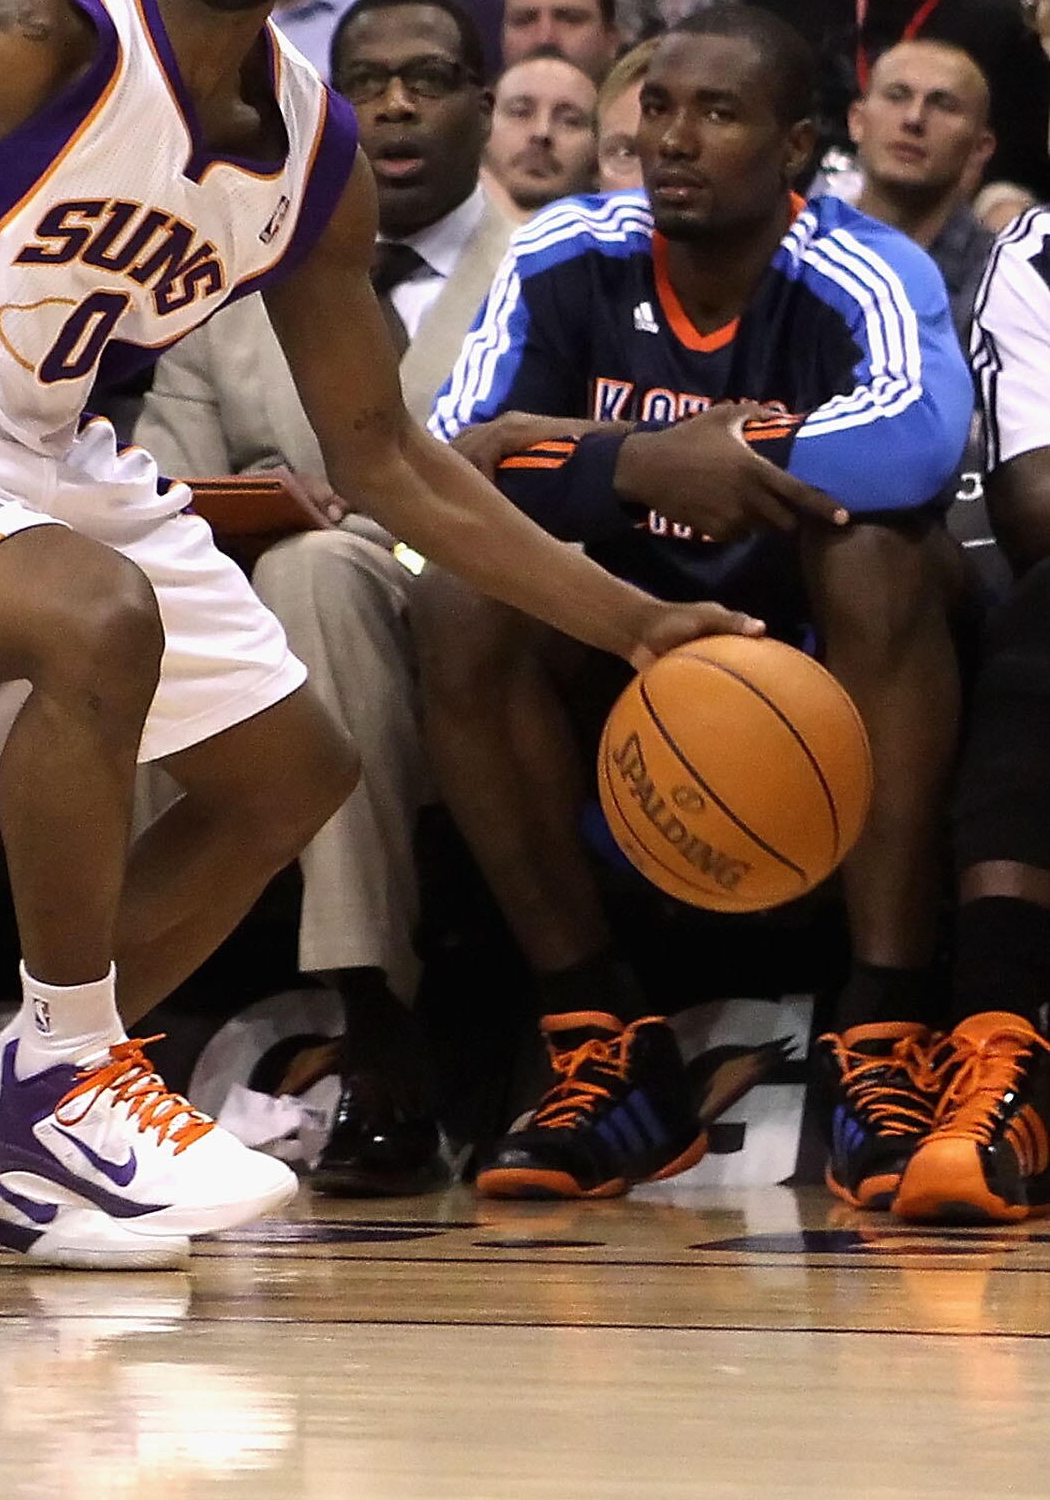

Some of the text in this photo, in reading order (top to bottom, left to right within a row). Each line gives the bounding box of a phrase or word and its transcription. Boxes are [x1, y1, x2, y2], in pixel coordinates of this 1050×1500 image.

[12, 197, 228, 316] SUNS
[38, 285, 132, 387] 0
[612, 730, 754, 891] SPALDING
